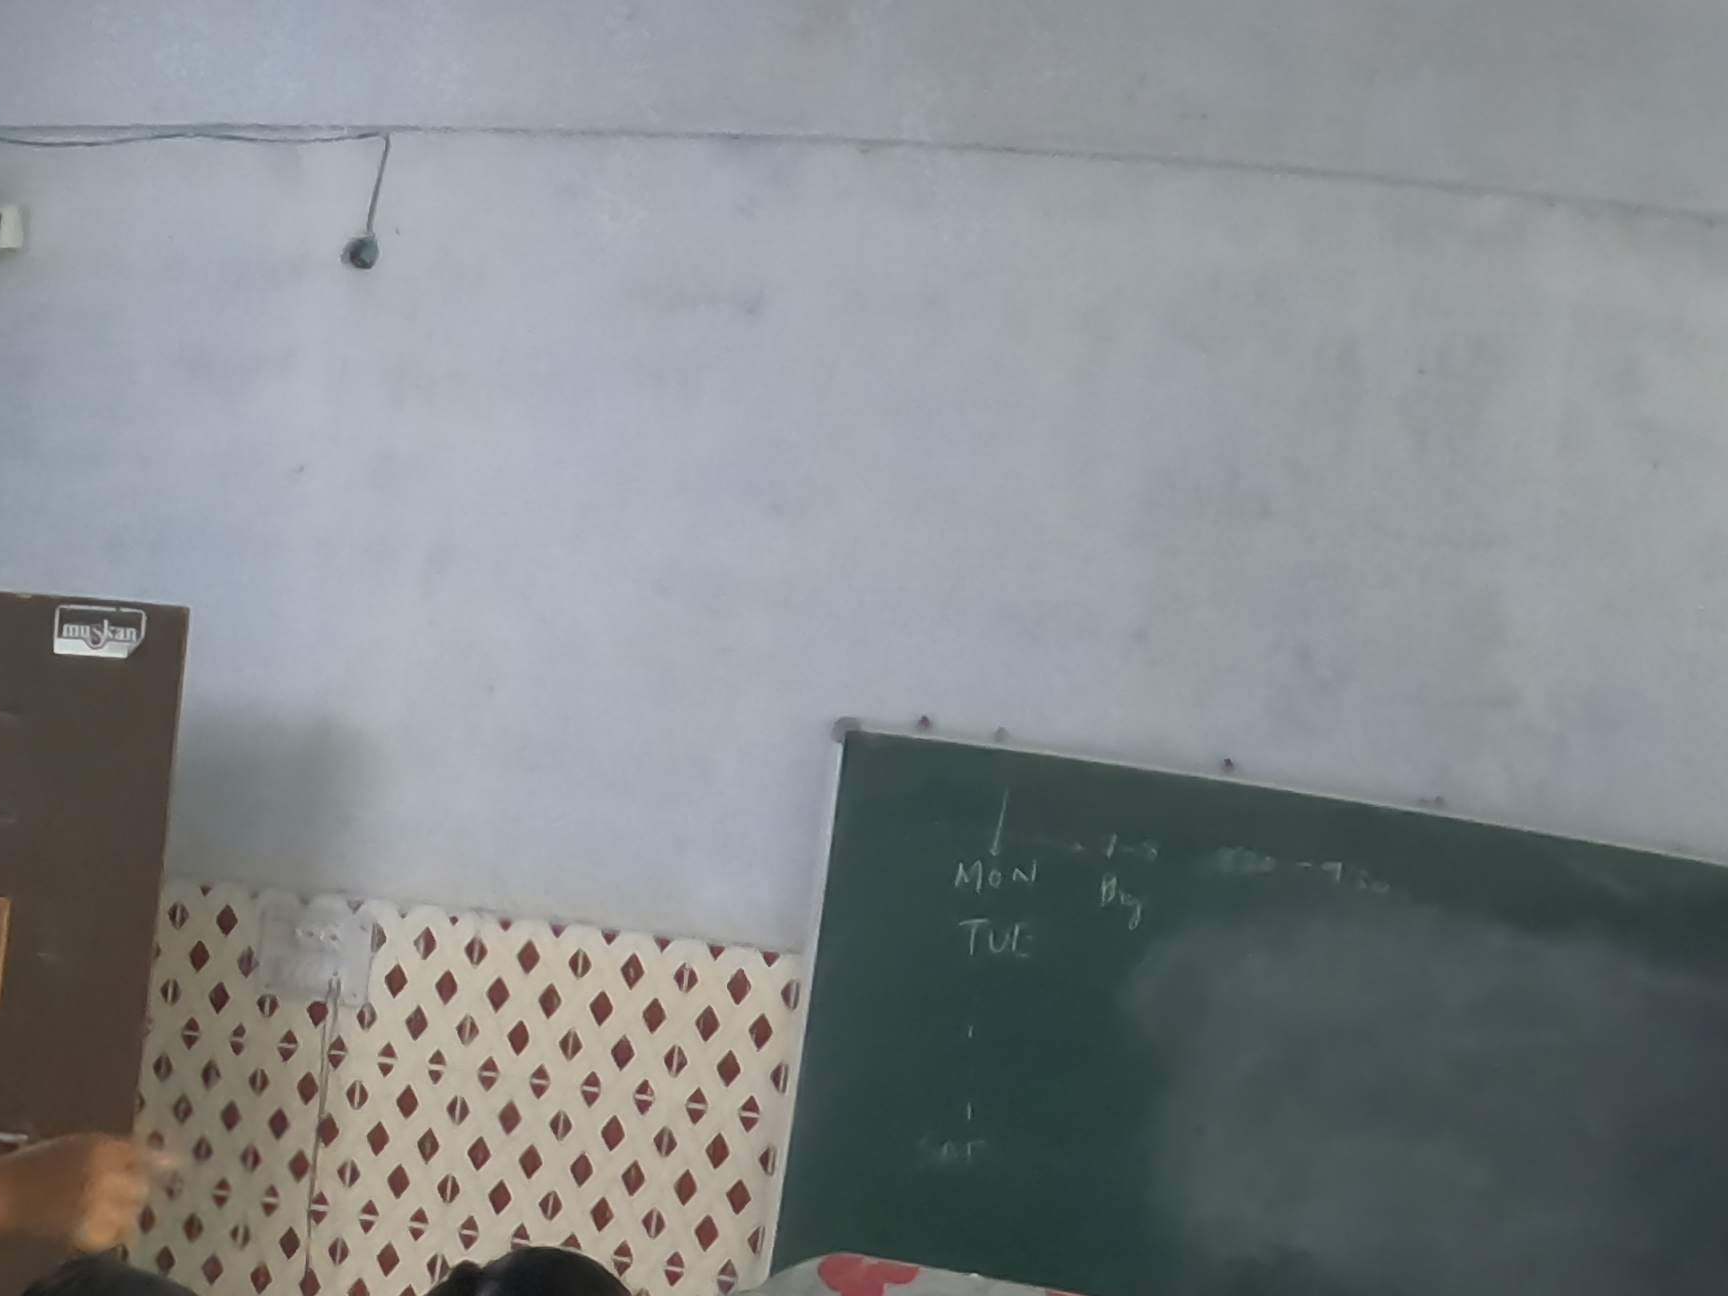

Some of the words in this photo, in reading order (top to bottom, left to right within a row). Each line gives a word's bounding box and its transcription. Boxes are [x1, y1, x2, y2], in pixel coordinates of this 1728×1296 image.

[62, 619, 137, 648] muskan
[954, 858, 1038, 895] MON
[958, 917, 1035, 958] TUE
